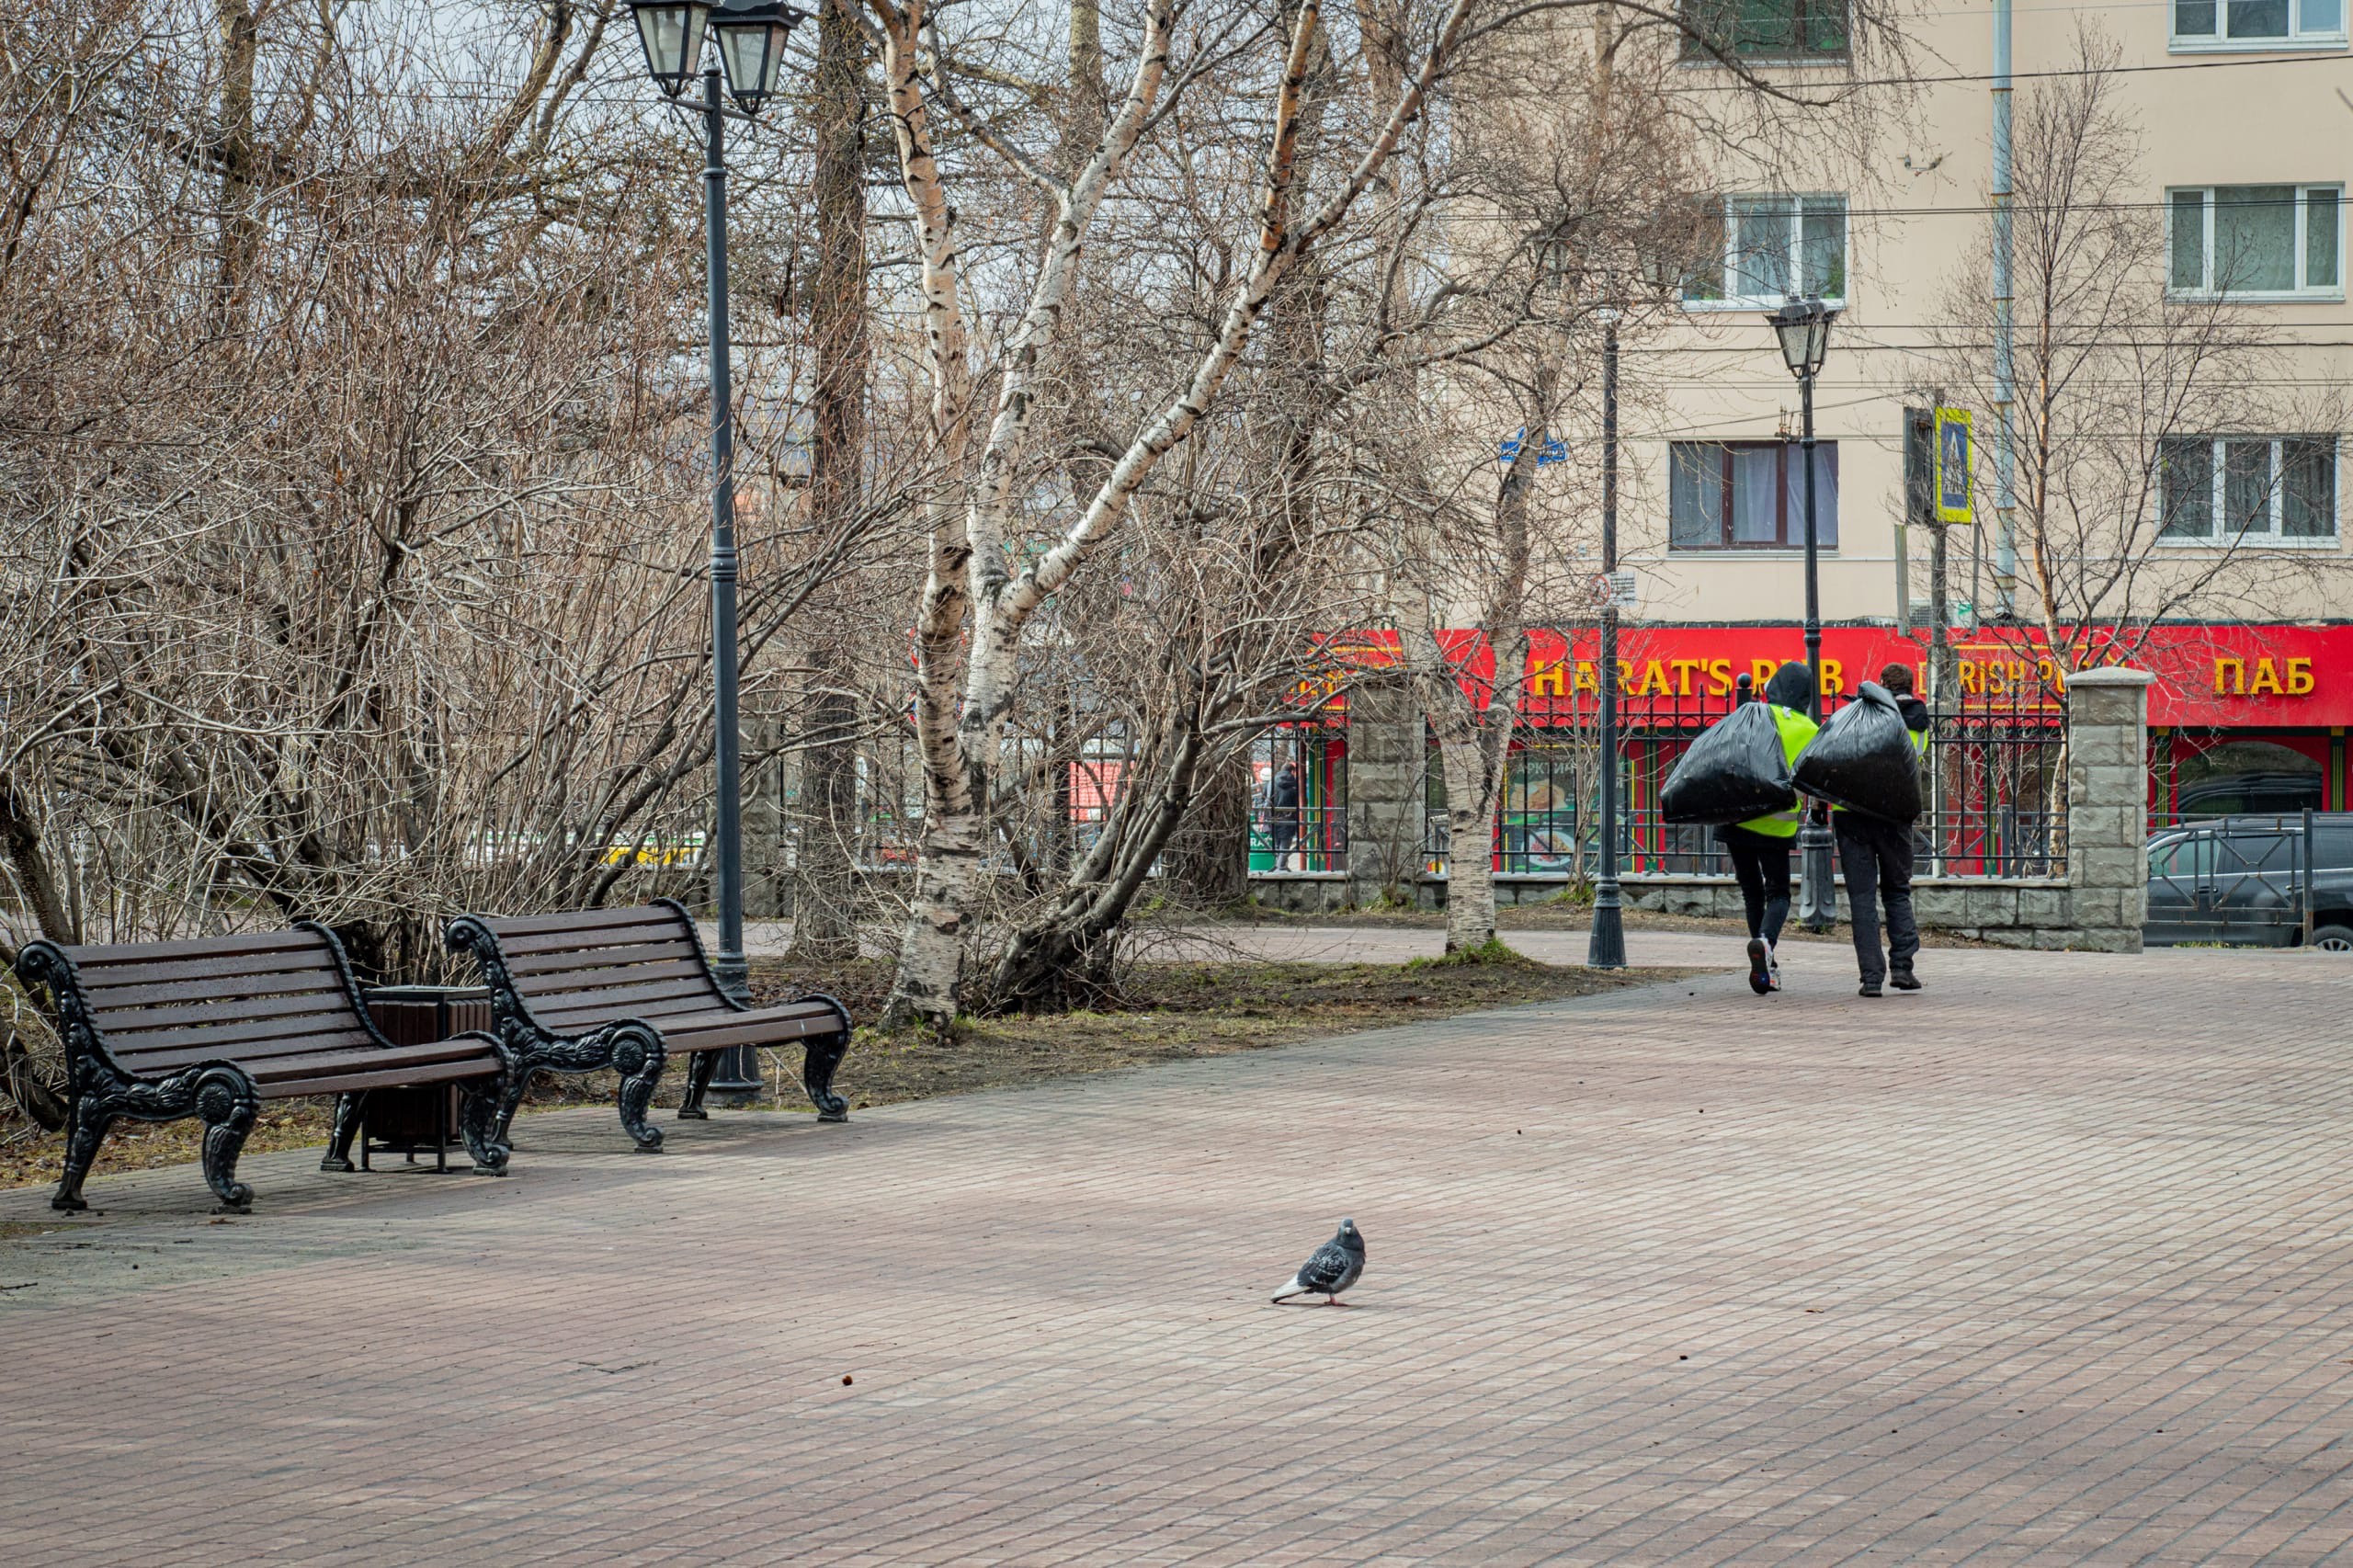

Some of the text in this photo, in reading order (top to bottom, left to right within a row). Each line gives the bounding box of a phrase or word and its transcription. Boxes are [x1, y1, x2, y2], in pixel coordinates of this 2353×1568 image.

[1533, 658, 1845, 697] HARAT'S PB
[1959, 660, 2026, 695] RISH
[2213, 656, 2315, 695] ПАБ
